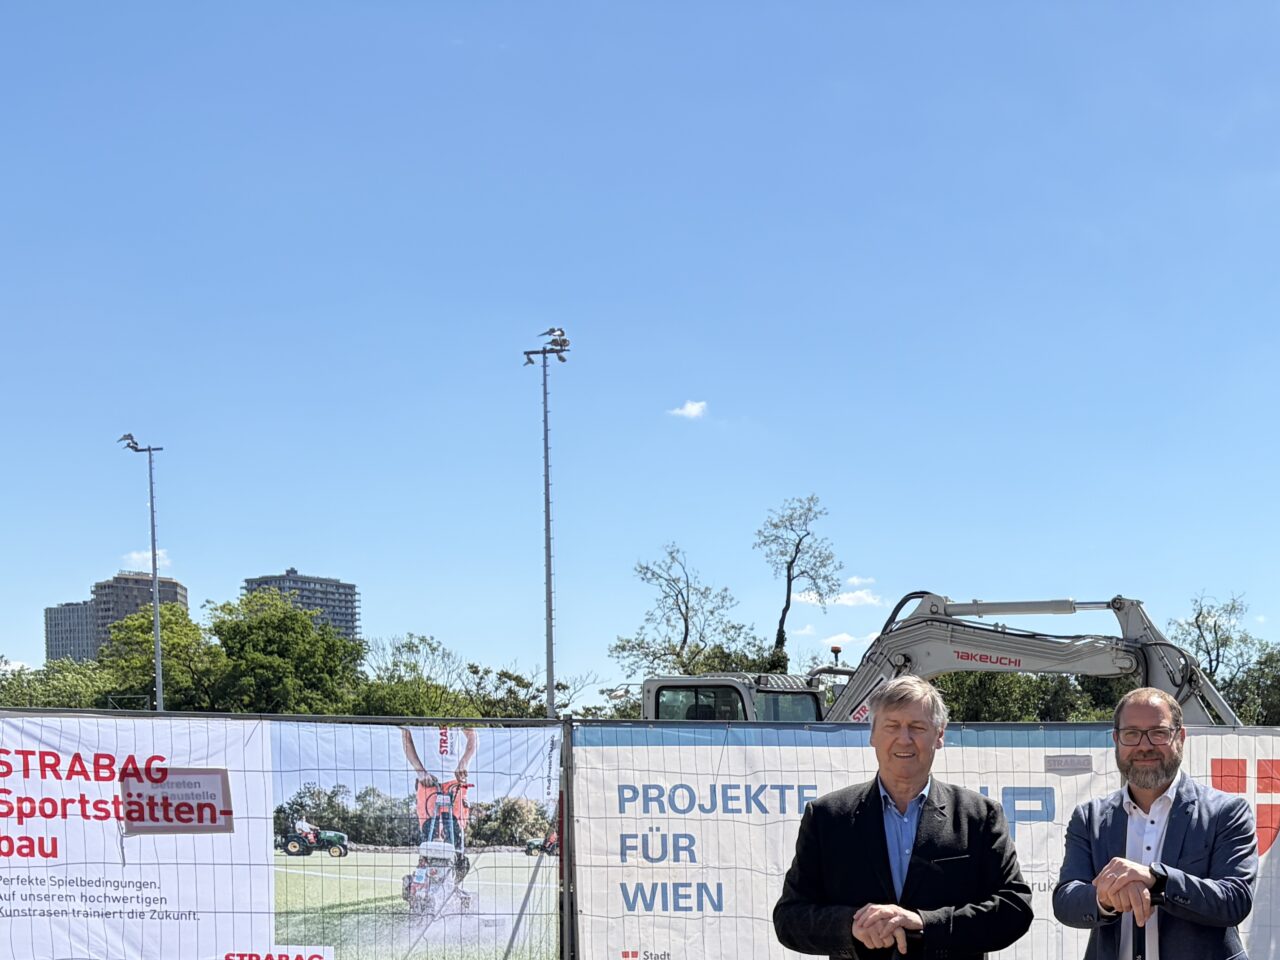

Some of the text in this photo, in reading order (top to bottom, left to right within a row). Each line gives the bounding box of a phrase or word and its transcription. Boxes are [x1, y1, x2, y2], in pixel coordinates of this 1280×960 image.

[0, 749, 168, 784] STRABAG
[617, 784, 818, 815] PROJEKTE
[619, 826, 697, 863] FÜR
[49, 876, 161, 890] Spielbedingungen.
[20, 893, 76, 903] unserem
[80, 892, 168, 907] hochwertigen
[620, 882, 723, 912] WIEN
[72, 908, 123, 919] trainiert
[127, 908, 146, 919] die
[150, 908, 201, 921] Zukunft.
[643, 951, 670, 960] Stadt
